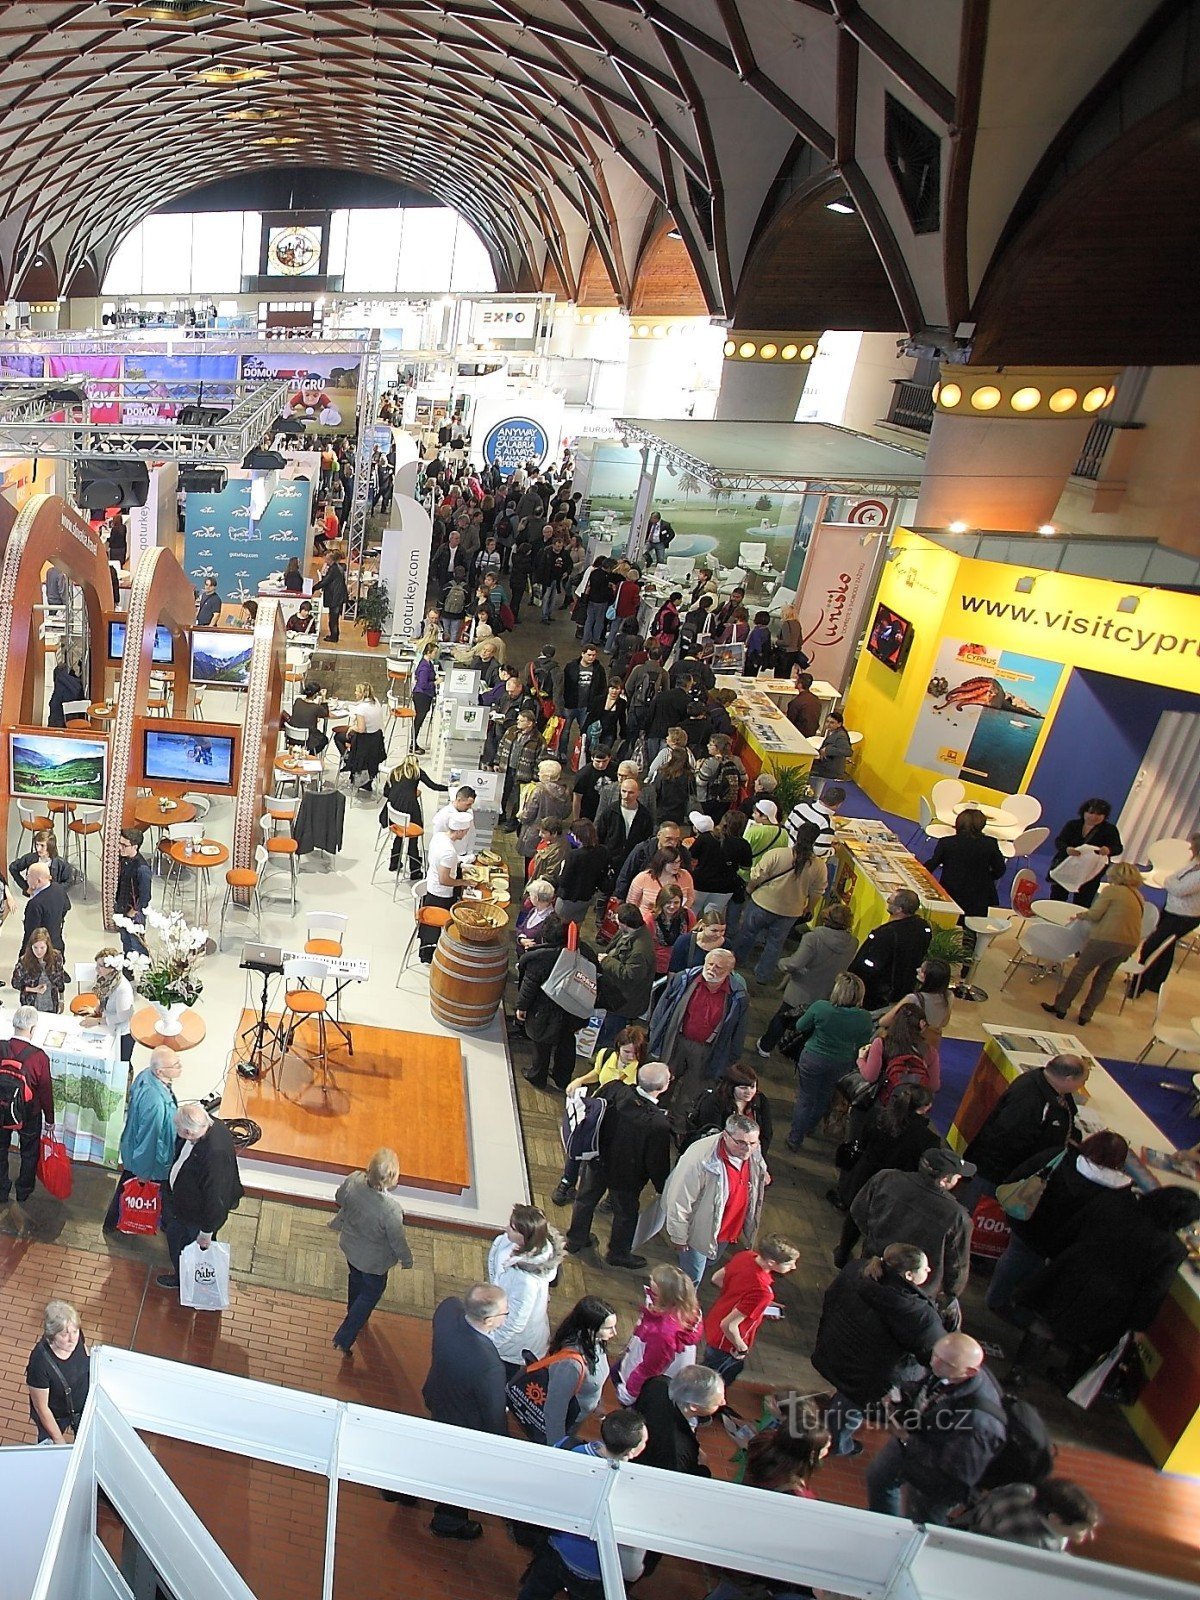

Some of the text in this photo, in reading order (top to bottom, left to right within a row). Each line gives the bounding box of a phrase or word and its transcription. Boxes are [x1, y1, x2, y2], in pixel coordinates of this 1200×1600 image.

[483, 312, 526, 323] EXPO
[244, 369, 278, 377] DOMOV
[126, 408, 159, 416] DOMOV
[498, 428, 538, 436] ANYWAY
[504, 448, 535, 456] ALWAYS
[402, 549, 420, 636] goturkey.com
[966, 653, 997, 666] CYPRUS
[977, 1216, 1011, 1233] 100+
[528, 1401, 545, 1418] HOTEL
